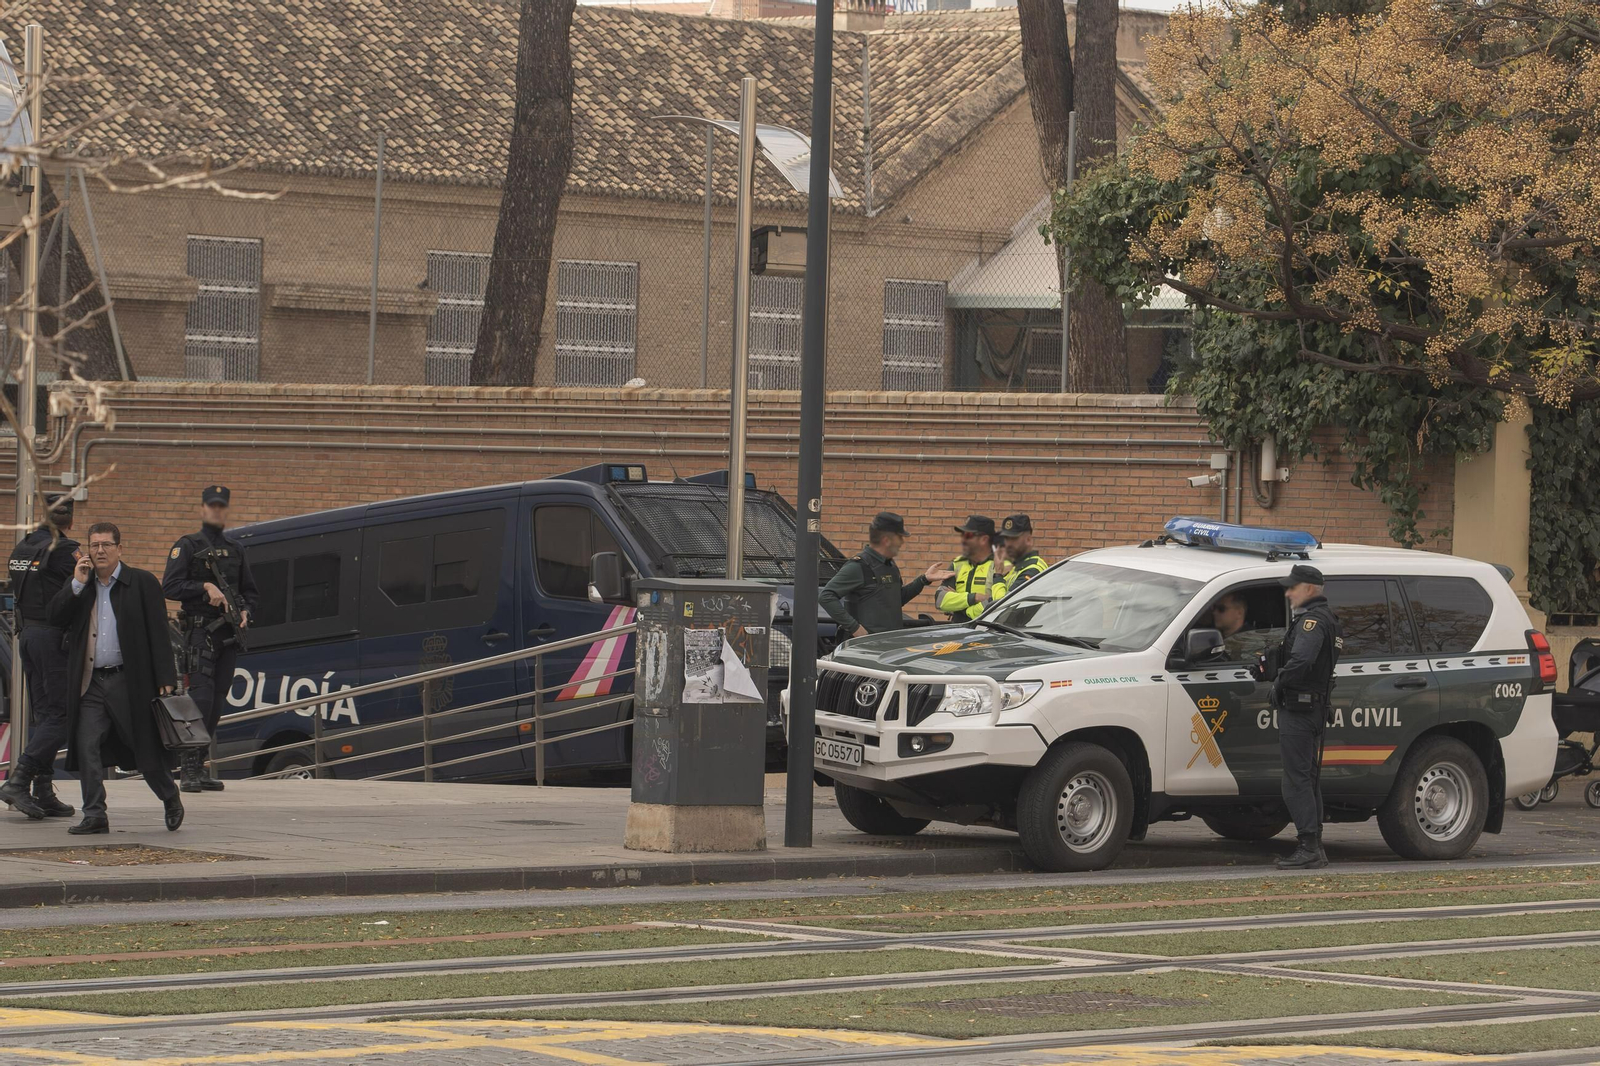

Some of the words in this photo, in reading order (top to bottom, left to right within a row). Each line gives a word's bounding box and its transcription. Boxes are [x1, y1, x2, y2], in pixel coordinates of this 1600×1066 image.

[1192, 522, 1220, 531] GUARDIA
[1193, 528, 1210, 536] CIVIL
[1084, 677, 1118, 685] GUARDIA
[226, 667, 360, 725] OLICÍA
[1502, 682, 1522, 698] 062
[1351, 707, 1402, 728] CIVIL
